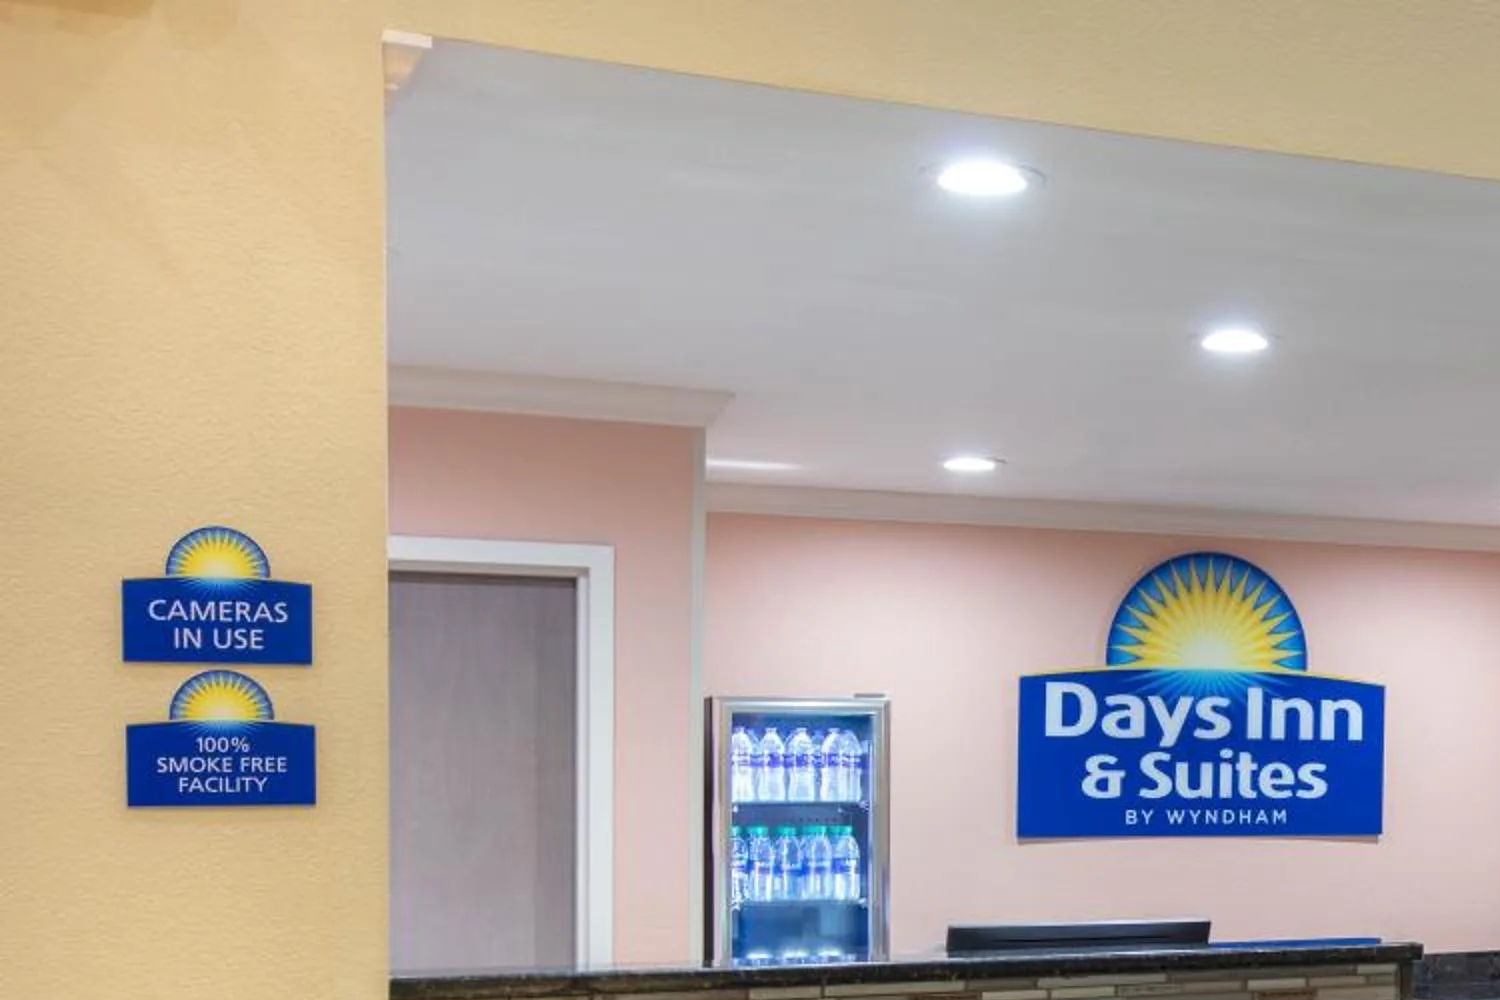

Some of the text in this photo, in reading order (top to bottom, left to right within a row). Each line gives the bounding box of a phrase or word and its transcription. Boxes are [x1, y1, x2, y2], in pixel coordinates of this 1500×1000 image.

[148, 599, 288, 623] CAMERAS
[174, 627, 264, 650] IN USE
[1045, 681, 1363, 748] Days Inn
[196, 736, 250, 753] 100%
[156, 756, 287, 773] SMOKE FREE
[1081, 748, 1328, 799] & Suites
[178, 776, 268, 793] FACILITY
[1125, 809, 1288, 825] BY WYNDHAM
